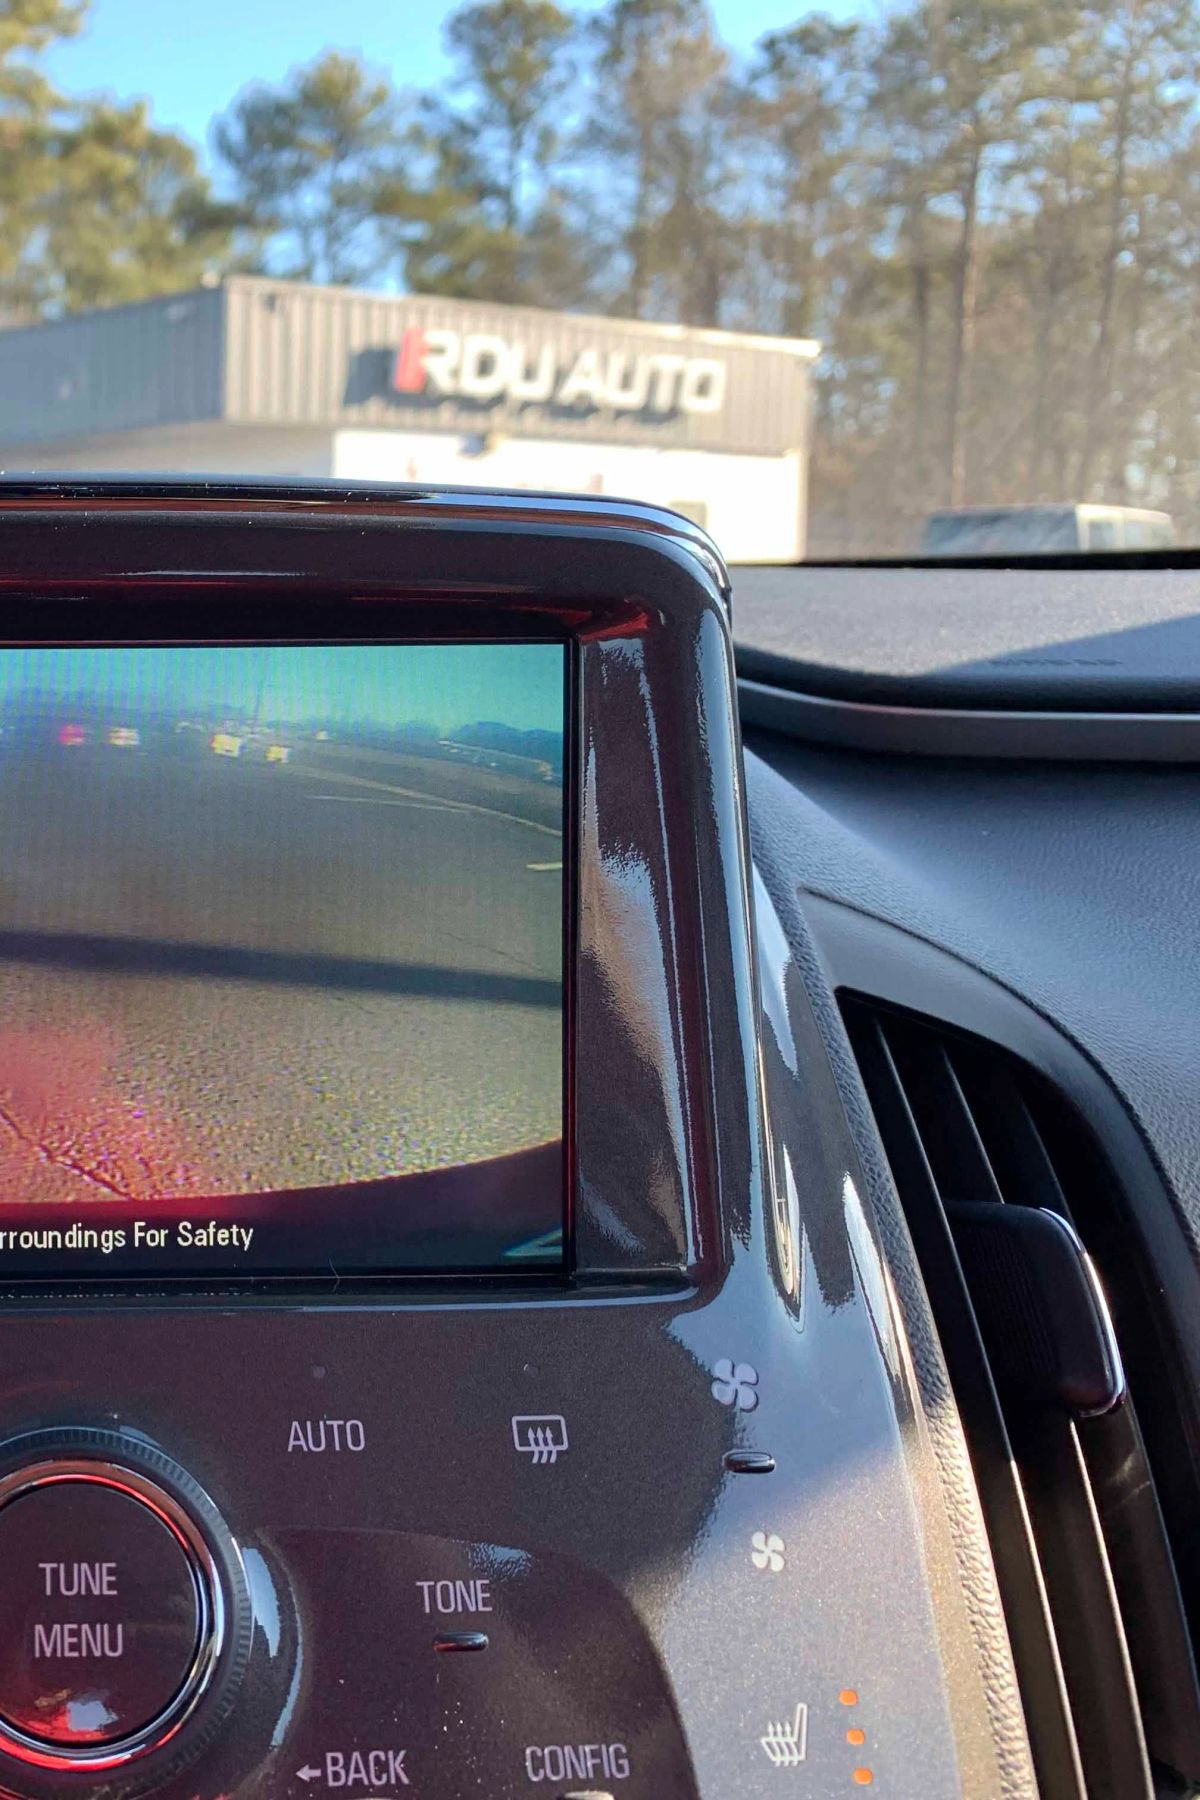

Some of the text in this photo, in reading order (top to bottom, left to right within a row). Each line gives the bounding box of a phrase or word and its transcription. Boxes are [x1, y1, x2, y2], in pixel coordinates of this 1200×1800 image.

[395, 328, 726, 413] RDU AUTO
[134, 1221, 169, 1248] For
[176, 1220, 254, 1251] Safety
[287, 1420, 366, 1453] AUTO
[38, 1562, 118, 1597] TUNE
[416, 1580, 493, 1614] TONE
[33, 1623, 124, 1658] MENU
[326, 1750, 411, 1787] BACK
[525, 1744, 631, 1782] CONFIG
